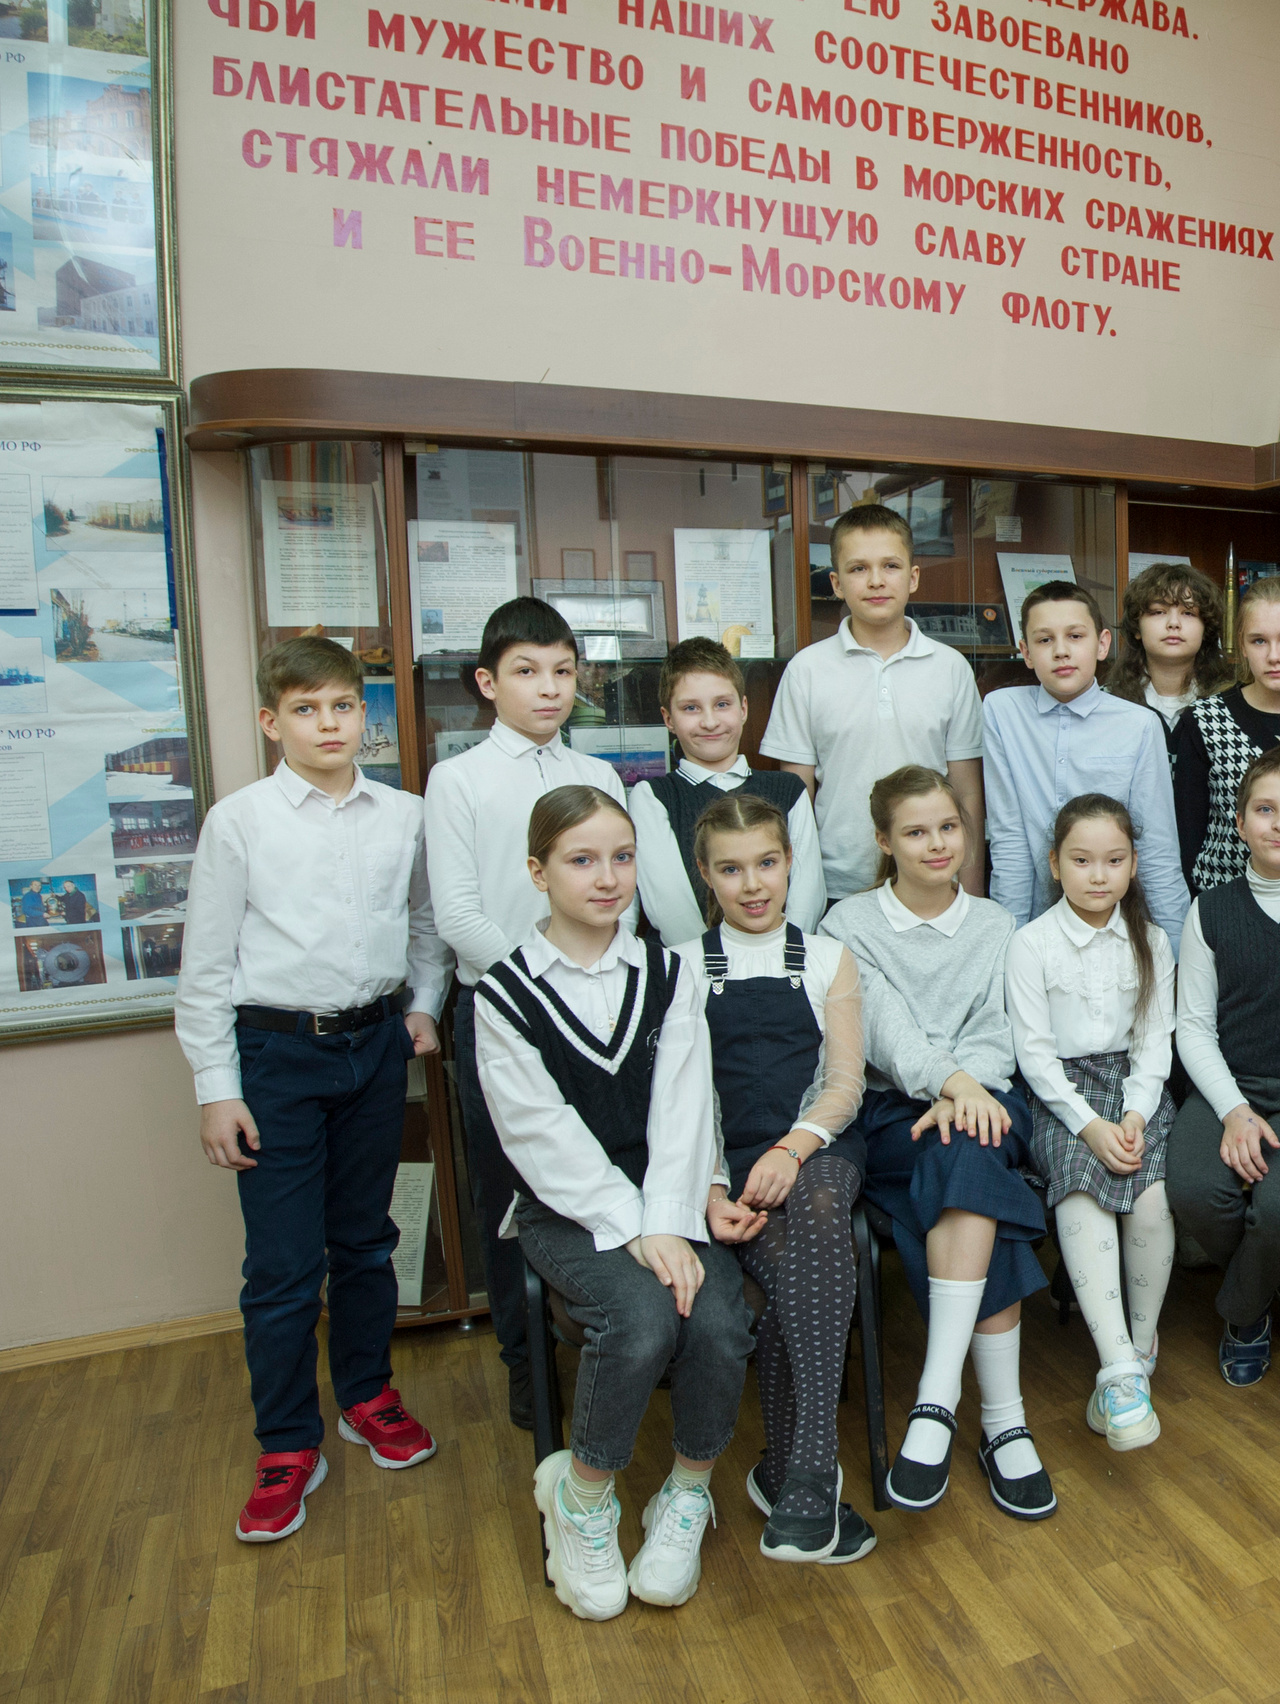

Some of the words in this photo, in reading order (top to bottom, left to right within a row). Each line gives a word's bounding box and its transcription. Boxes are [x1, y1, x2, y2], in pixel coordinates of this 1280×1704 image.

[931, 0, 1129, 74] ЗАВОЕВАНО
[1028, 0, 1198, 40] ЖАВА.
[6, 52, 26, 63] РФ
[619, 0, 774, 52] НАШИХ
[815, 31, 1212, 148] СООТЕЧЕСТВЕННИКОВ,
[208, 0, 315, 39] ЧЬИ
[368, 10, 644, 90] МУЖЕСТВО
[681, 64, 706, 102] И
[749, 79, 1171, 190] САМООТВЕРЖЕННОСТЬ,
[213, 56, 630, 153] БЛИСТАТЕЛЬНЫЕ
[661, 123, 830, 184] ПОБЕДЫ
[856, 156, 878, 190] В
[904, 164, 1064, 224] МОРСКИХ
[1086, 199, 1274, 261] СРАЖЕНИЯХ
[243, 130, 489, 195] СТЯЖАЛИ
[538, 166, 878, 246] НЕМЕРКНУЩУЮ
[915, 223, 1026, 268] СЛАВУ
[1061, 246, 1180, 292] СТРАНЕ
[333, 207, 363, 249] И
[415, 217, 474, 260] ЕЕ
[1002, 292, 1116, 337] ФЛОТУ.
[21, 441, 41, 451] РФ
[8, 729, 32, 739] МО
[36, 728, 56, 738] РФ
[922, 1405, 940, 1414] BACK
[1000, 1428, 1023, 1441] SCHOOL
